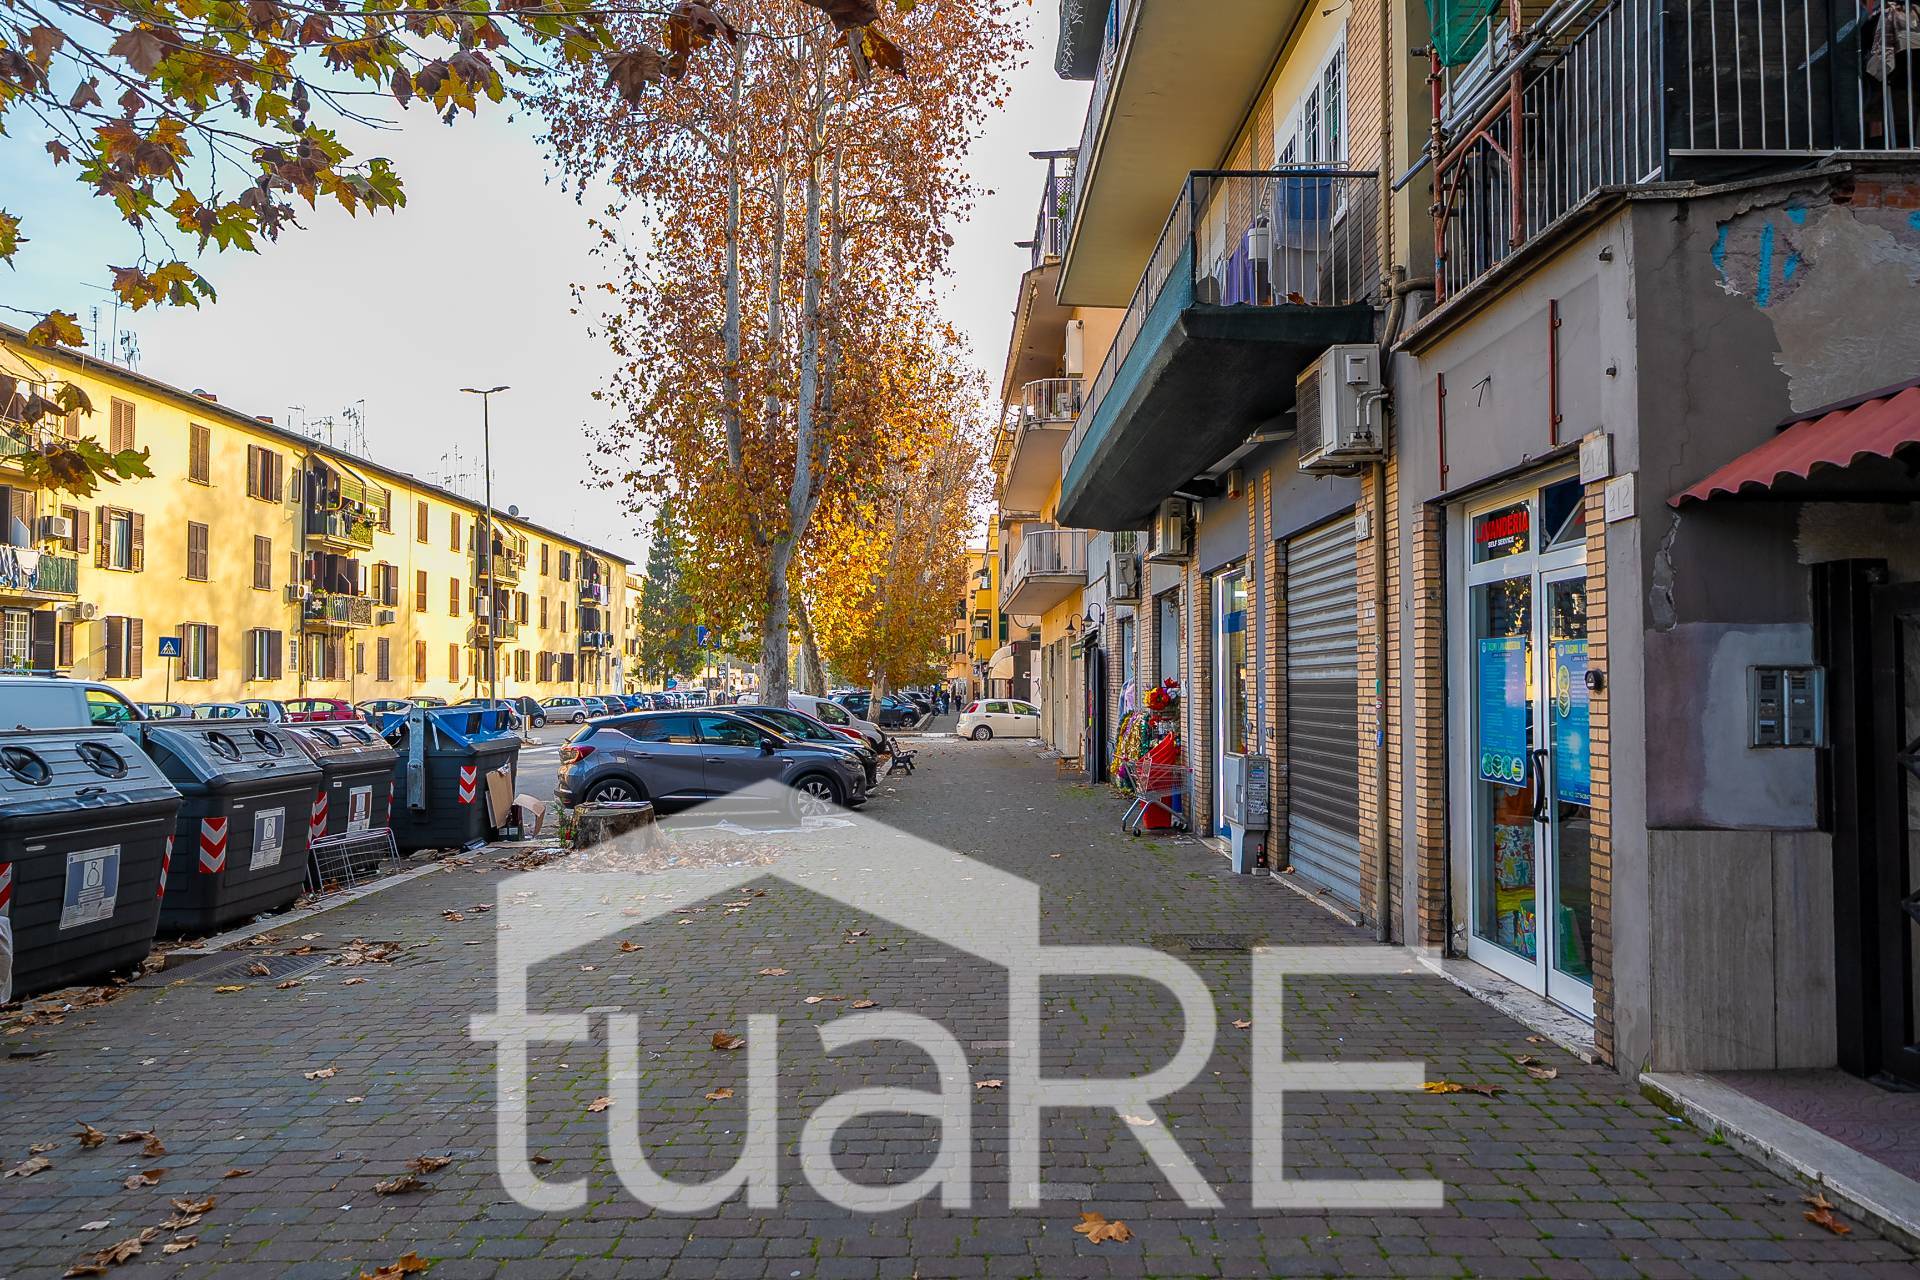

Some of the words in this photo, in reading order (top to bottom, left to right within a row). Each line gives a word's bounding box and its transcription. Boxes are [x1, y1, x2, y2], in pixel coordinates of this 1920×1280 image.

[1607, 484, 1630, 513] 212
[1476, 511, 1528, 543] LAVANDERIA
[1487, 540, 1497, 548] SELF
[1498, 535, 1515, 546] SERVICE
